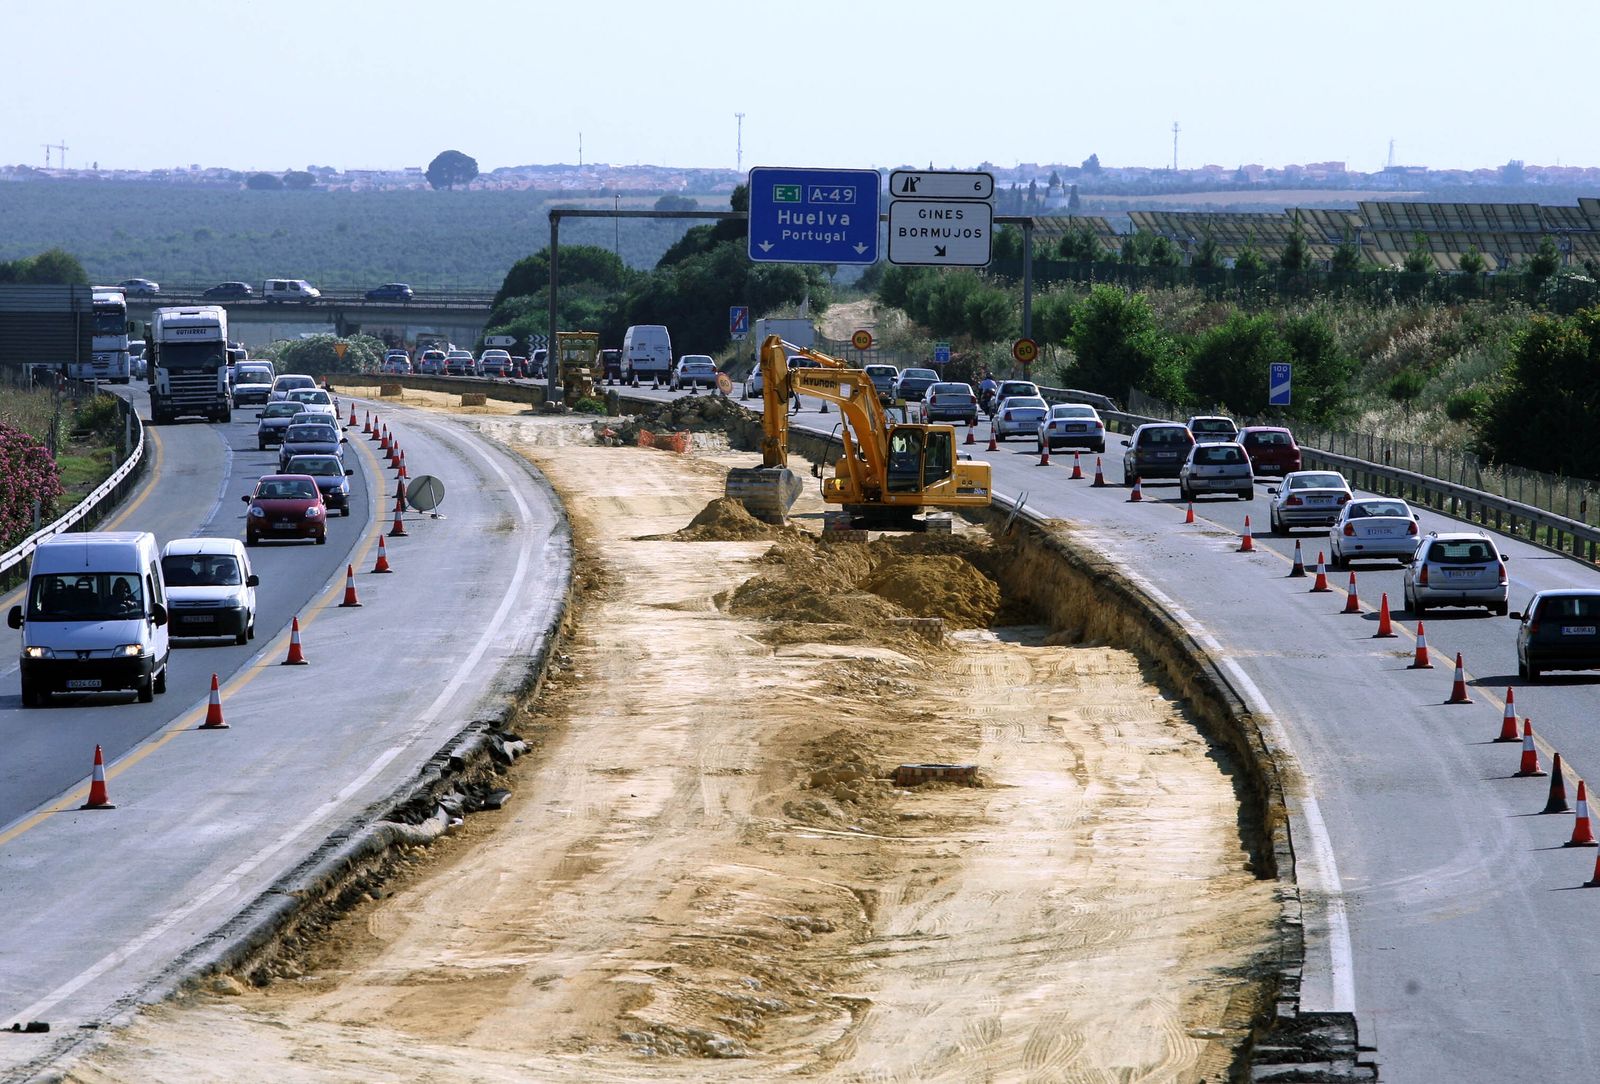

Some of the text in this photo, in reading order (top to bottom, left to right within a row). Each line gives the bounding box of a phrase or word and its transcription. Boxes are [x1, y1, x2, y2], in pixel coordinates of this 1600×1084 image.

[973, 181, 982, 191] 6
[775, 187, 799, 201] E-1
[811, 188, 854, 202] A-49
[777, 210, 850, 226] Huelva
[918, 209, 964, 220] GINES
[782, 230, 846, 243] Portugal
[899, 227, 982, 239] BORMUJOS
[176, 328, 207, 336] GUTIERREZ
[856, 336, 868, 344] 60
[1019, 346, 1032, 356] 60
[720, 380, 730, 388] 60
[803, 376, 838, 389] HYUNDAI
